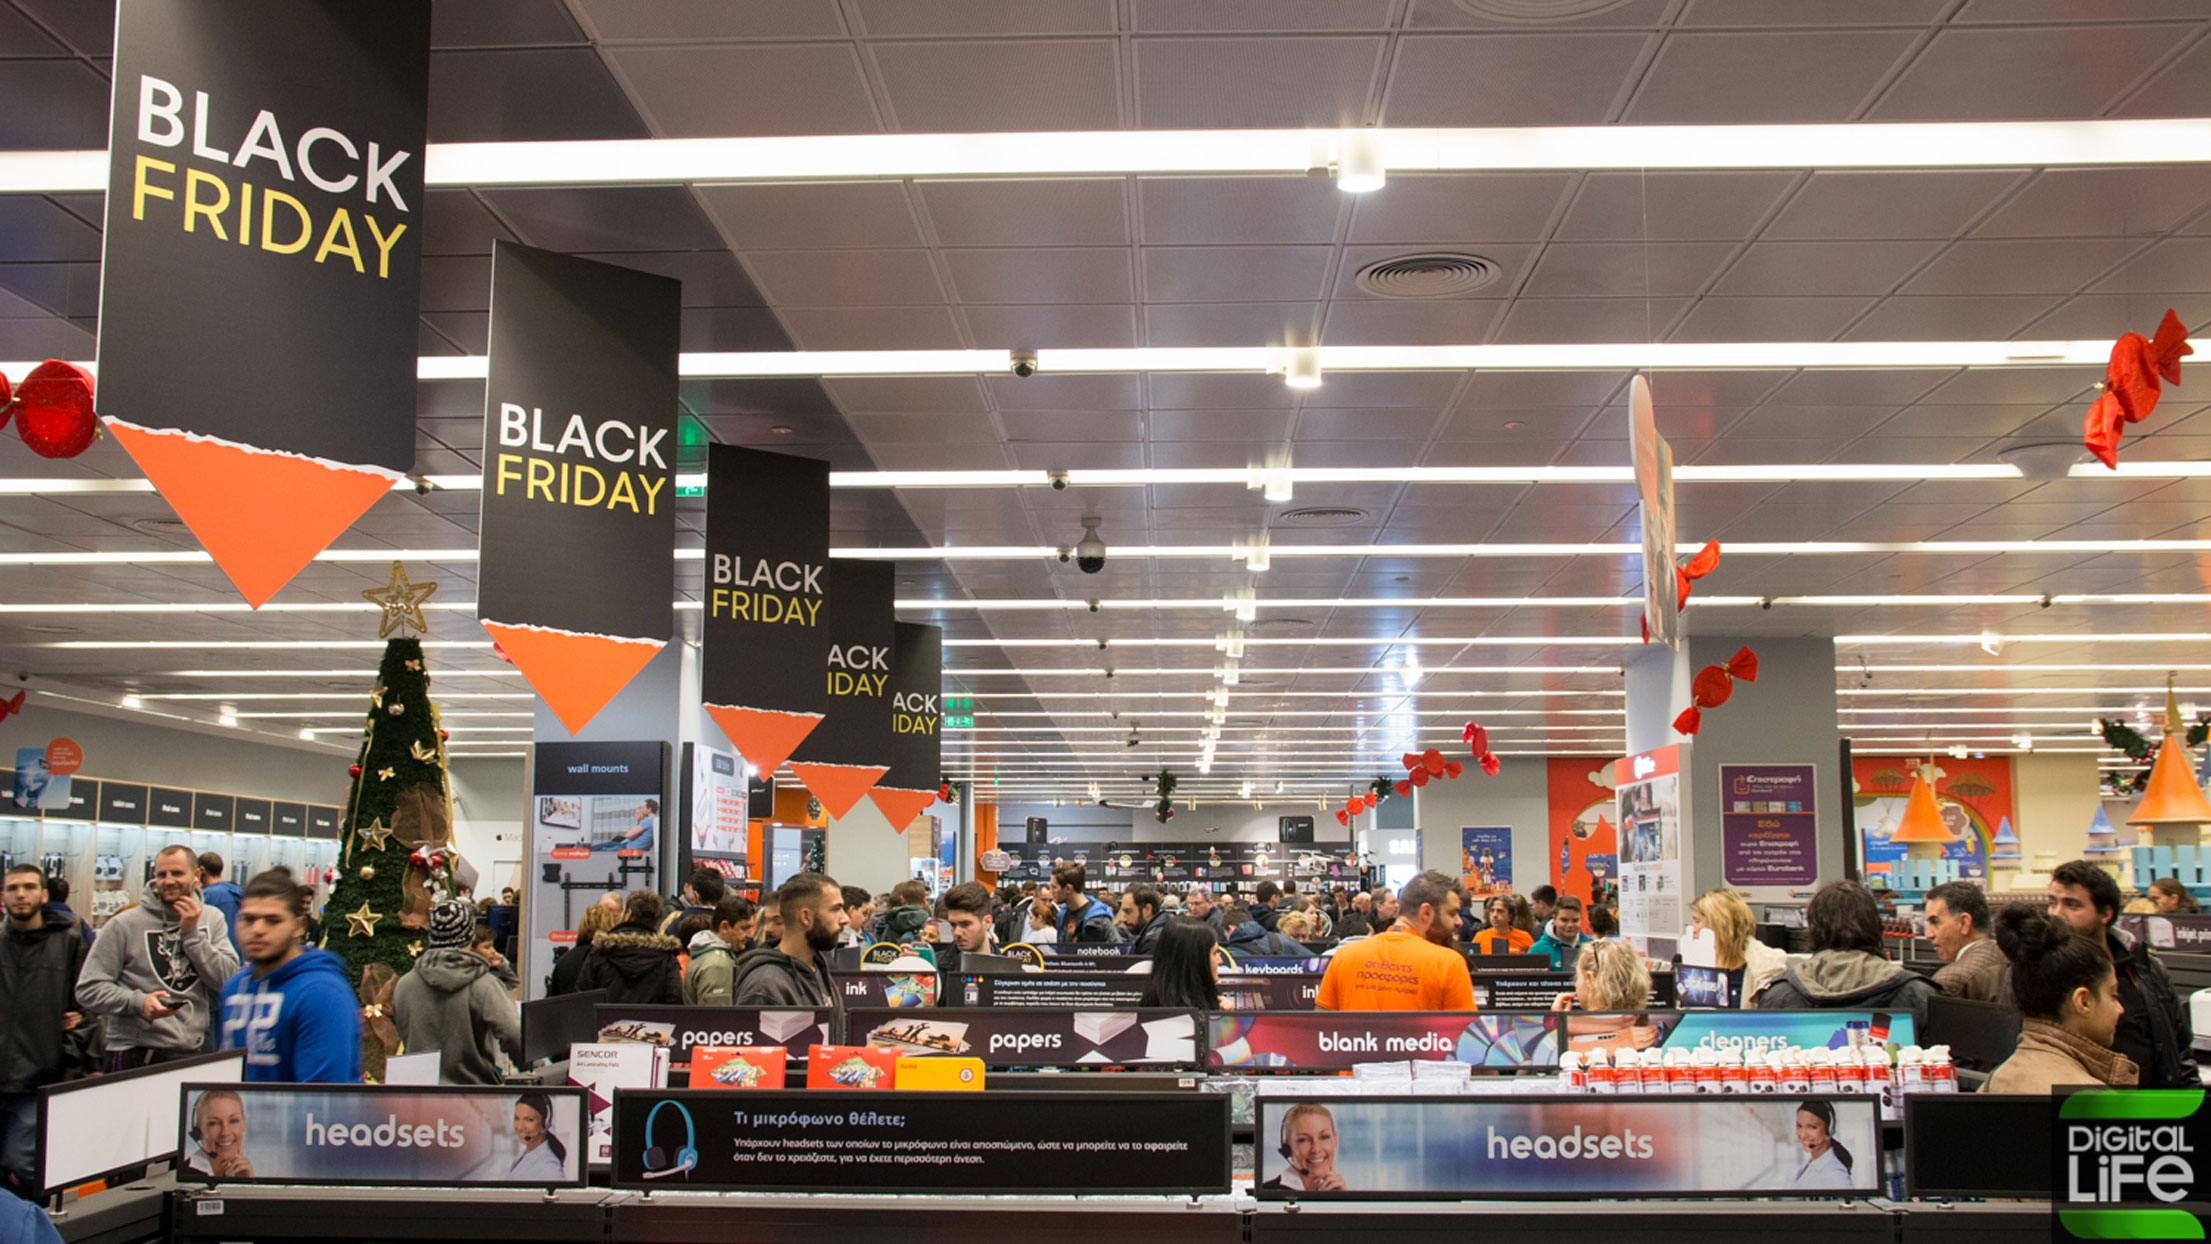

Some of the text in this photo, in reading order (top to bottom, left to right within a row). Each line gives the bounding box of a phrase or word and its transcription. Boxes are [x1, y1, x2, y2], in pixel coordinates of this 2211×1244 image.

[137, 74, 411, 213] BLACK
[131, 153, 408, 279] FRIDAY
[498, 402, 668, 469] BLACK
[496, 455, 666, 516] FRIDAY
[713, 553, 824, 594] BLACK
[712, 588, 822, 627] FRIDAY
[827, 644, 889, 671] ACK
[827, 672, 889, 697] IDAY
[892, 692, 938, 714] ACK
[892, 714, 937, 735] IDAY
[567, 764, 629, 774] wall mounts
[1077, 946, 1121, 956] notebook
[1245, 964, 1304, 974] keyboards
[845, 982, 867, 995] ink
[682, 1025, 753, 1050] papers
[989, 1027, 1062, 1053] papers
[1319, 1031, 1452, 1052] blank media
[1700, 1030, 1788, 1050] cleaners
[305, 1113, 465, 1149] headsets
[734, 1111, 906, 1127] Τι μικρόφωνο θέλετε;
[733, 1138, 781, 1149] Υπάρχουν
[783, 1138, 824, 1148] headsets
[846, 1139, 879, 1149] οποίων
[894, 1139, 947, 1150] μικρόφωνο
[949, 1139, 971, 1149] είναι
[1037, 1140, 1060, 1150] ώστε
[1062, 1142, 1074, 1150] να
[1076, 1141, 1116, 1151] μπορείτε
[1118, 1142, 1130, 1150] να
[1132, 1142, 1143, 1150] το
[1487, 1125, 1654, 1160] headsets
[733, 1153, 755, 1162] όταν
[757, 1153, 773, 1162] δεν
[787, 1153, 837, 1164] χρειάζεστε,
[839, 1154, 853, 1164] για
[855, 1155, 867, 1163] να
[869, 1153, 892, 1164] έχετε
[894, 1154, 952, 1165] περισσότερη
[954, 1154, 985, 1164] άνεση.
